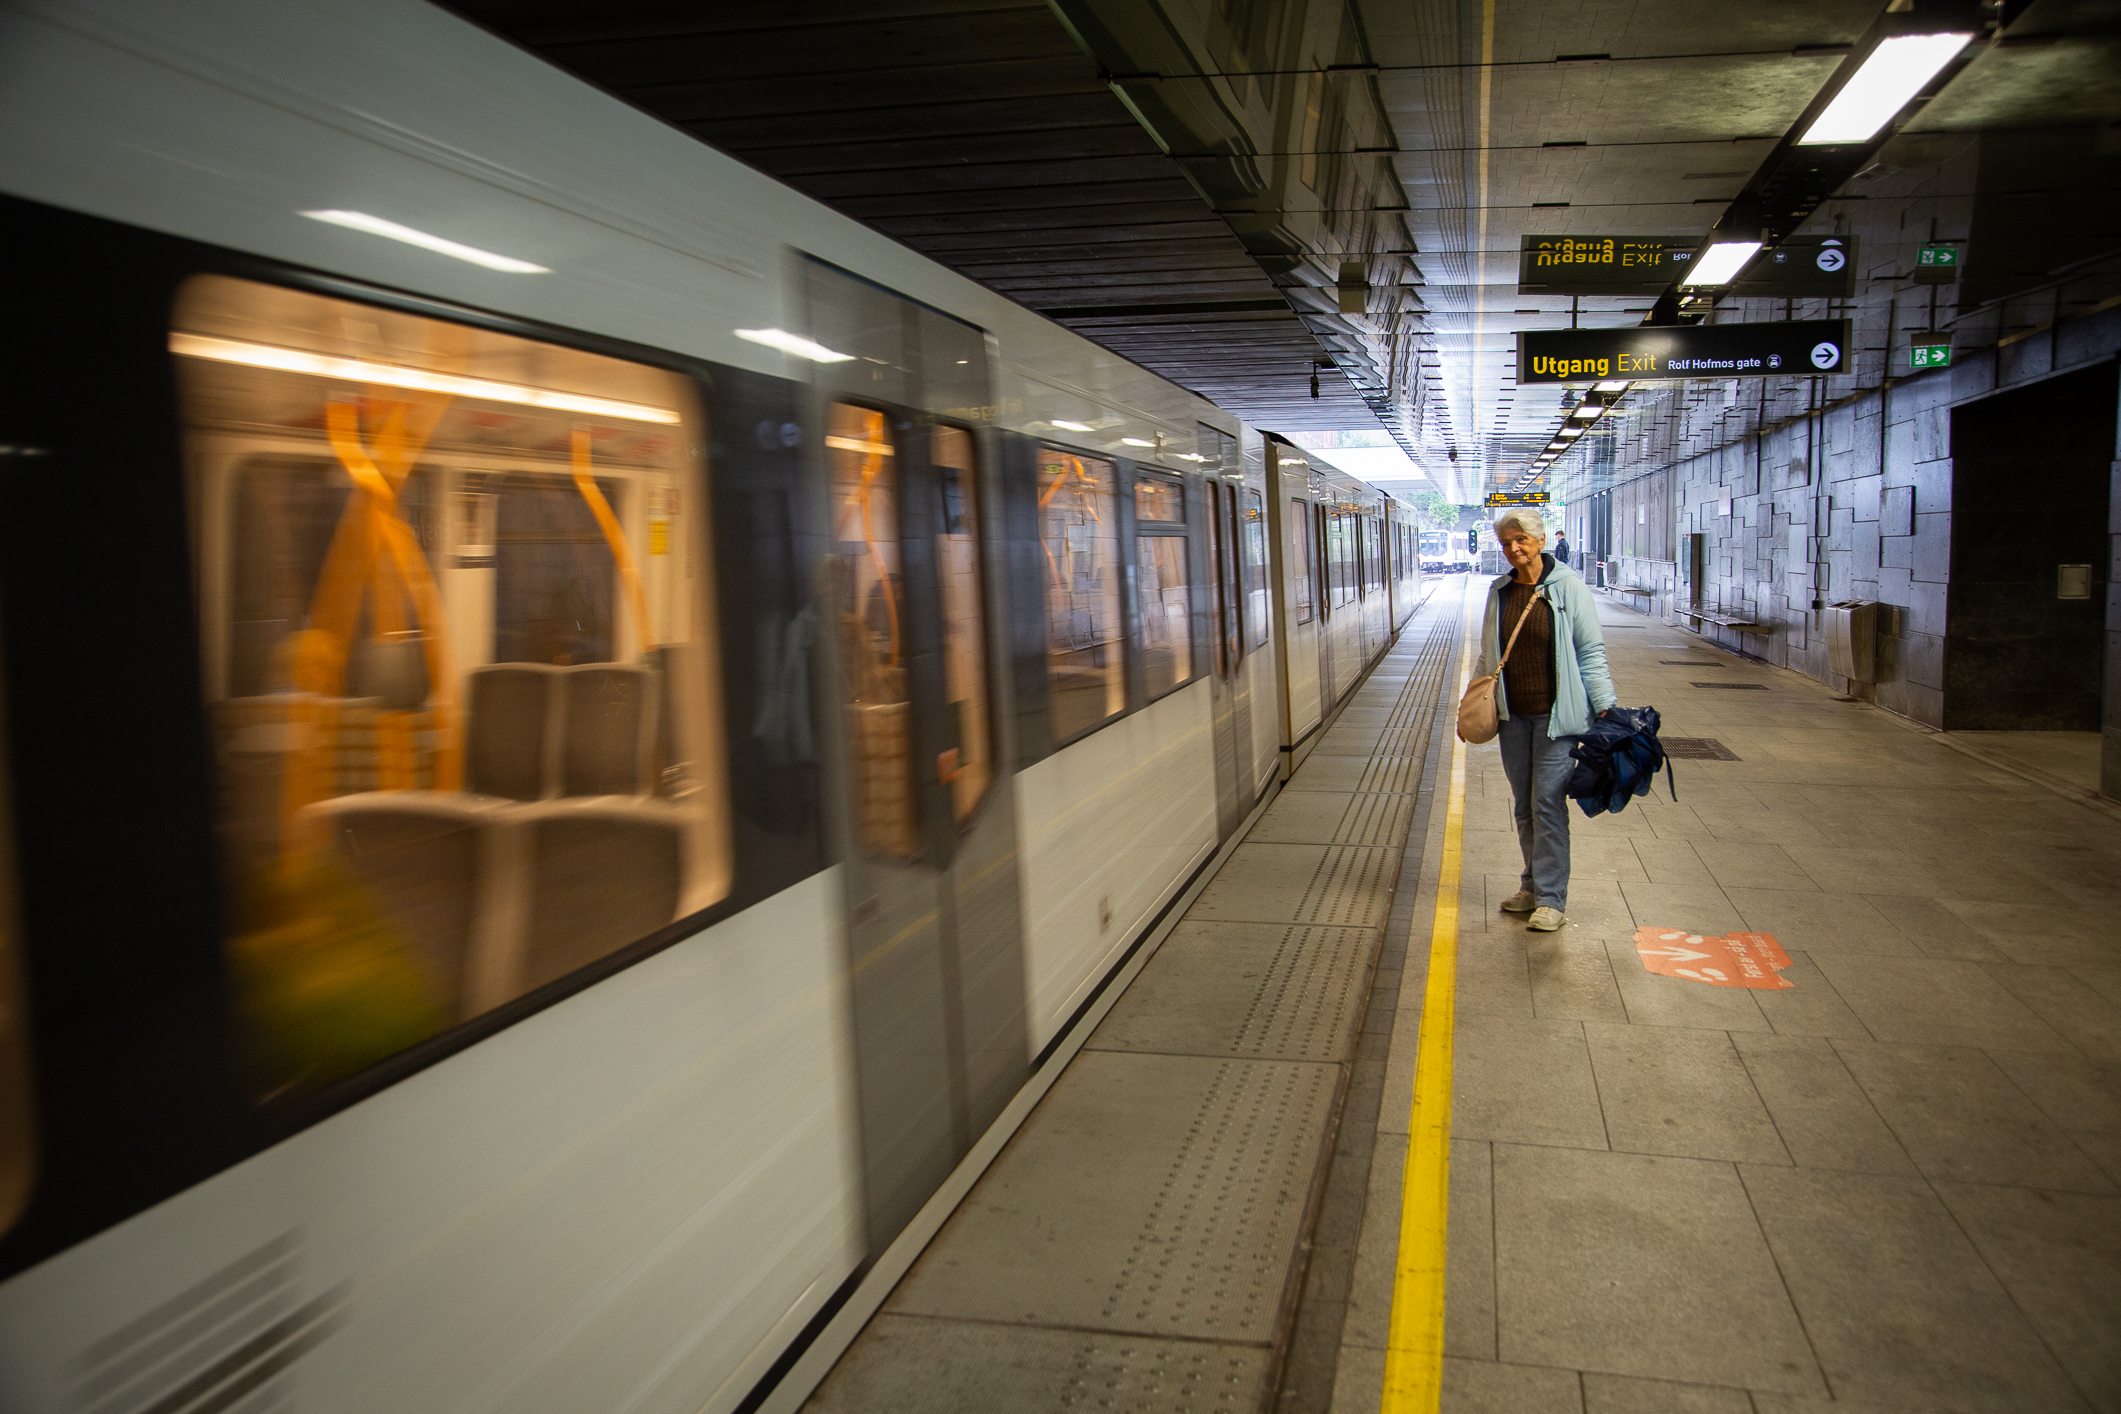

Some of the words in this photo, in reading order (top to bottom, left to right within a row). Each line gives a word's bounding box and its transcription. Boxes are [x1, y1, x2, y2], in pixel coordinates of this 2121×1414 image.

[1533, 356, 1609, 378] Utgang
[1618, 353, 1657, 372] Exit
[1668, 360, 1690, 370] Rolf
[1693, 358, 1734, 369] Hofmos
[1737, 358, 1761, 370] gate
